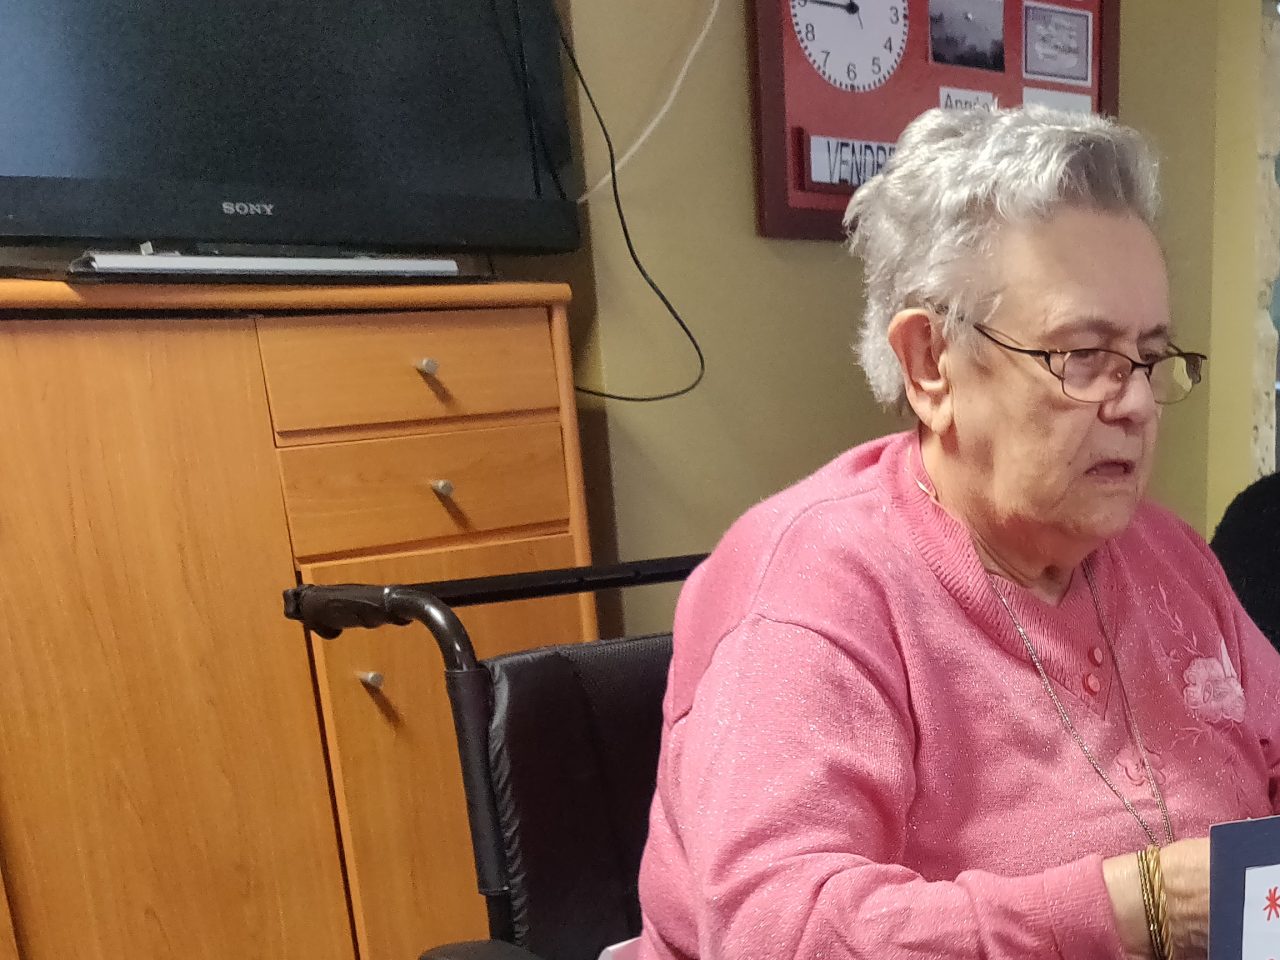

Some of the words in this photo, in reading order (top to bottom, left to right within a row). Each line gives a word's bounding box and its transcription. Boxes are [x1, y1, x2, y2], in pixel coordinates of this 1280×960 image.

[889, 6, 899, 25] 3
[805, 23, 816, 42] 8
[883, 36, 893, 54] 4
[821, 50, 831, 68] 7
[871, 56, 882, 75] 5
[846, 63, 857, 81] 6
[827, 140, 896, 185] VENDR
[222, 202, 274, 215] SONY
